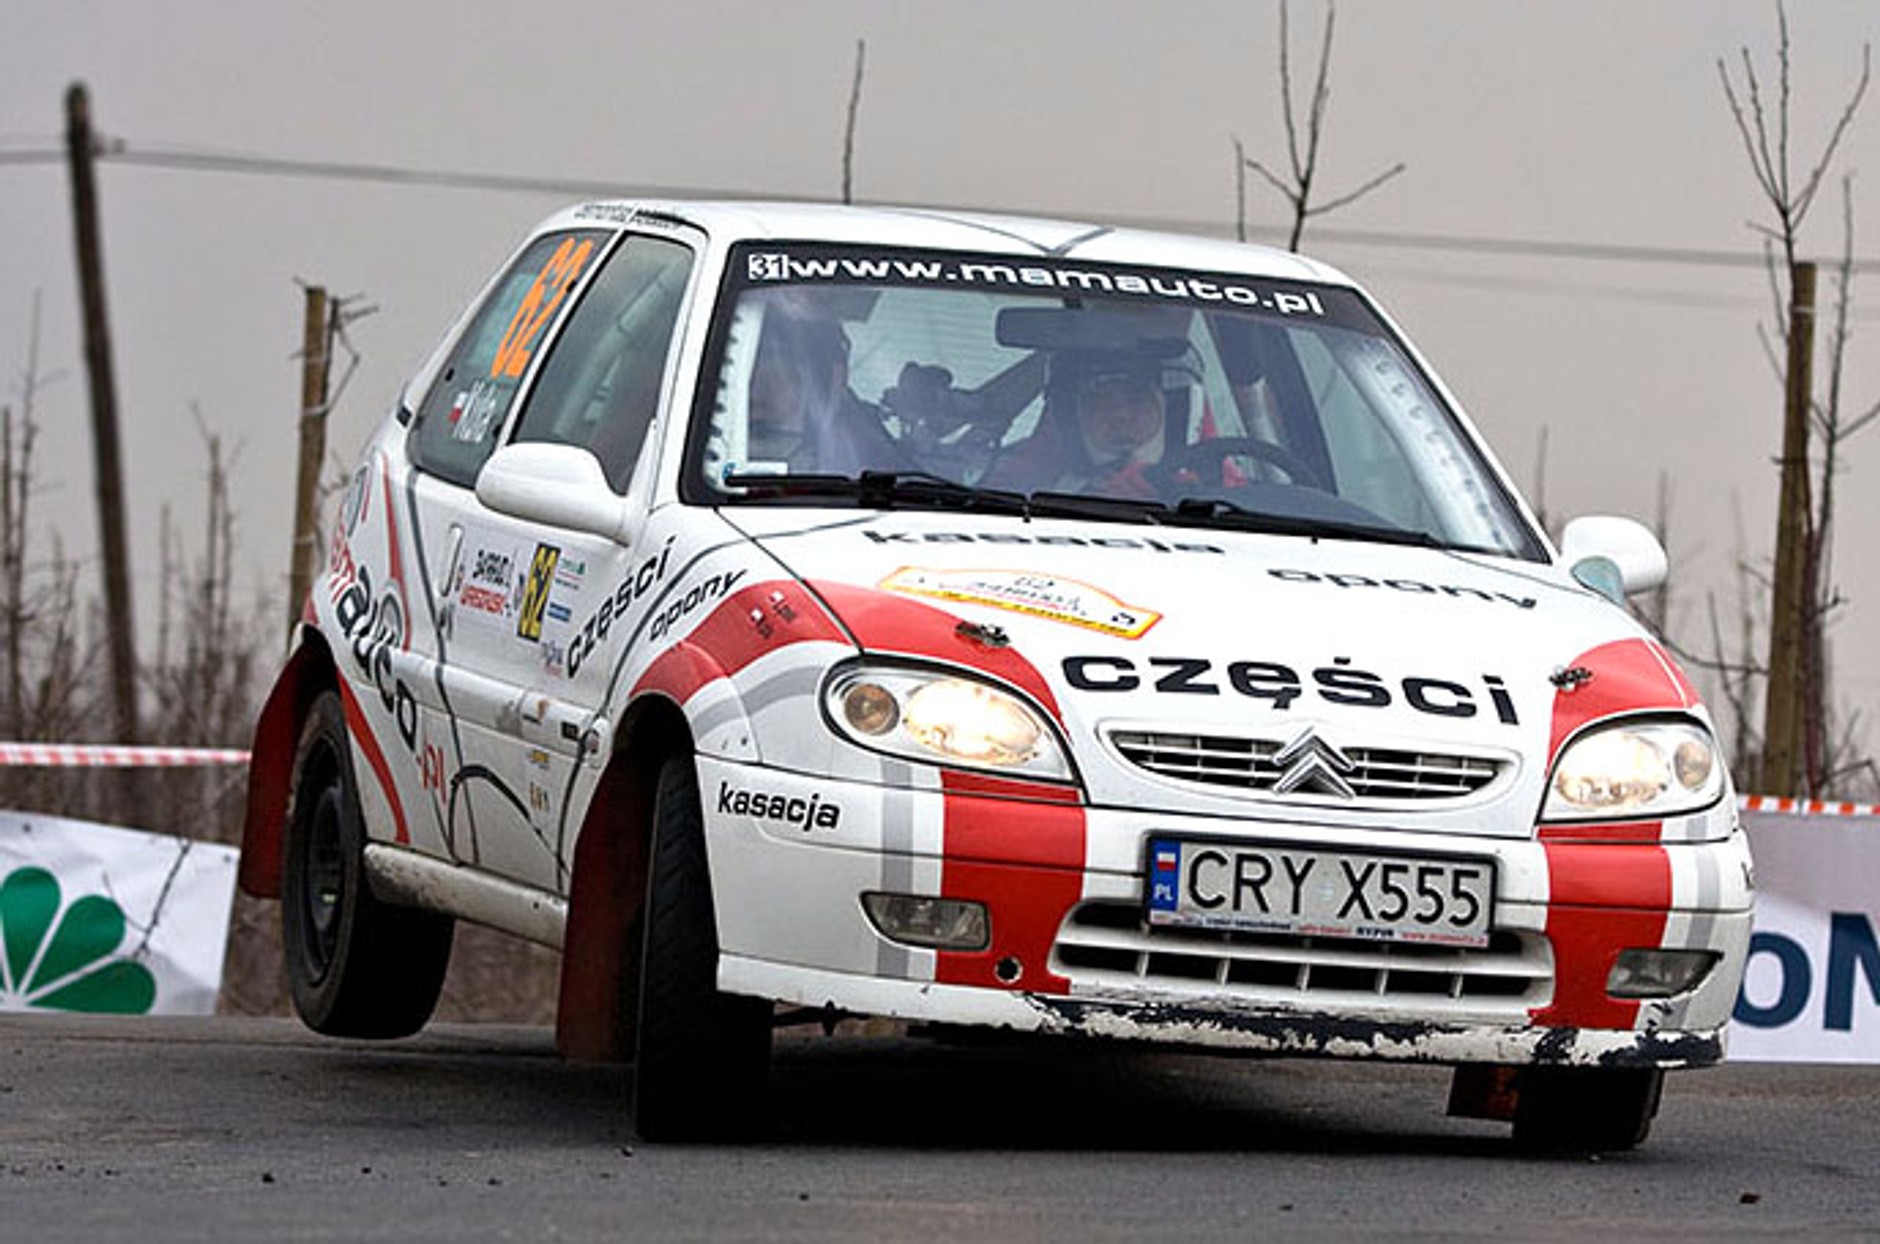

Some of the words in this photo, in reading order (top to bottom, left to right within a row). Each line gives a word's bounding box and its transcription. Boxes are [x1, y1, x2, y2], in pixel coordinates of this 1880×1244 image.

[489, 237, 592, 379] 62
[749, 253, 789, 280] 31
[788, 257, 1324, 316] www.mamauto.pl
[863, 531, 1226, 553] kasacja
[650, 569, 747, 642] opony
[1267, 569, 1537, 609] opony
[1062, 655, 1519, 725] części
[718, 781, 840, 832] kasacja
[1154, 884, 1173, 901] PL
[1189, 850, 1315, 915] CRY
[1337, 860, 1480, 927] X555
